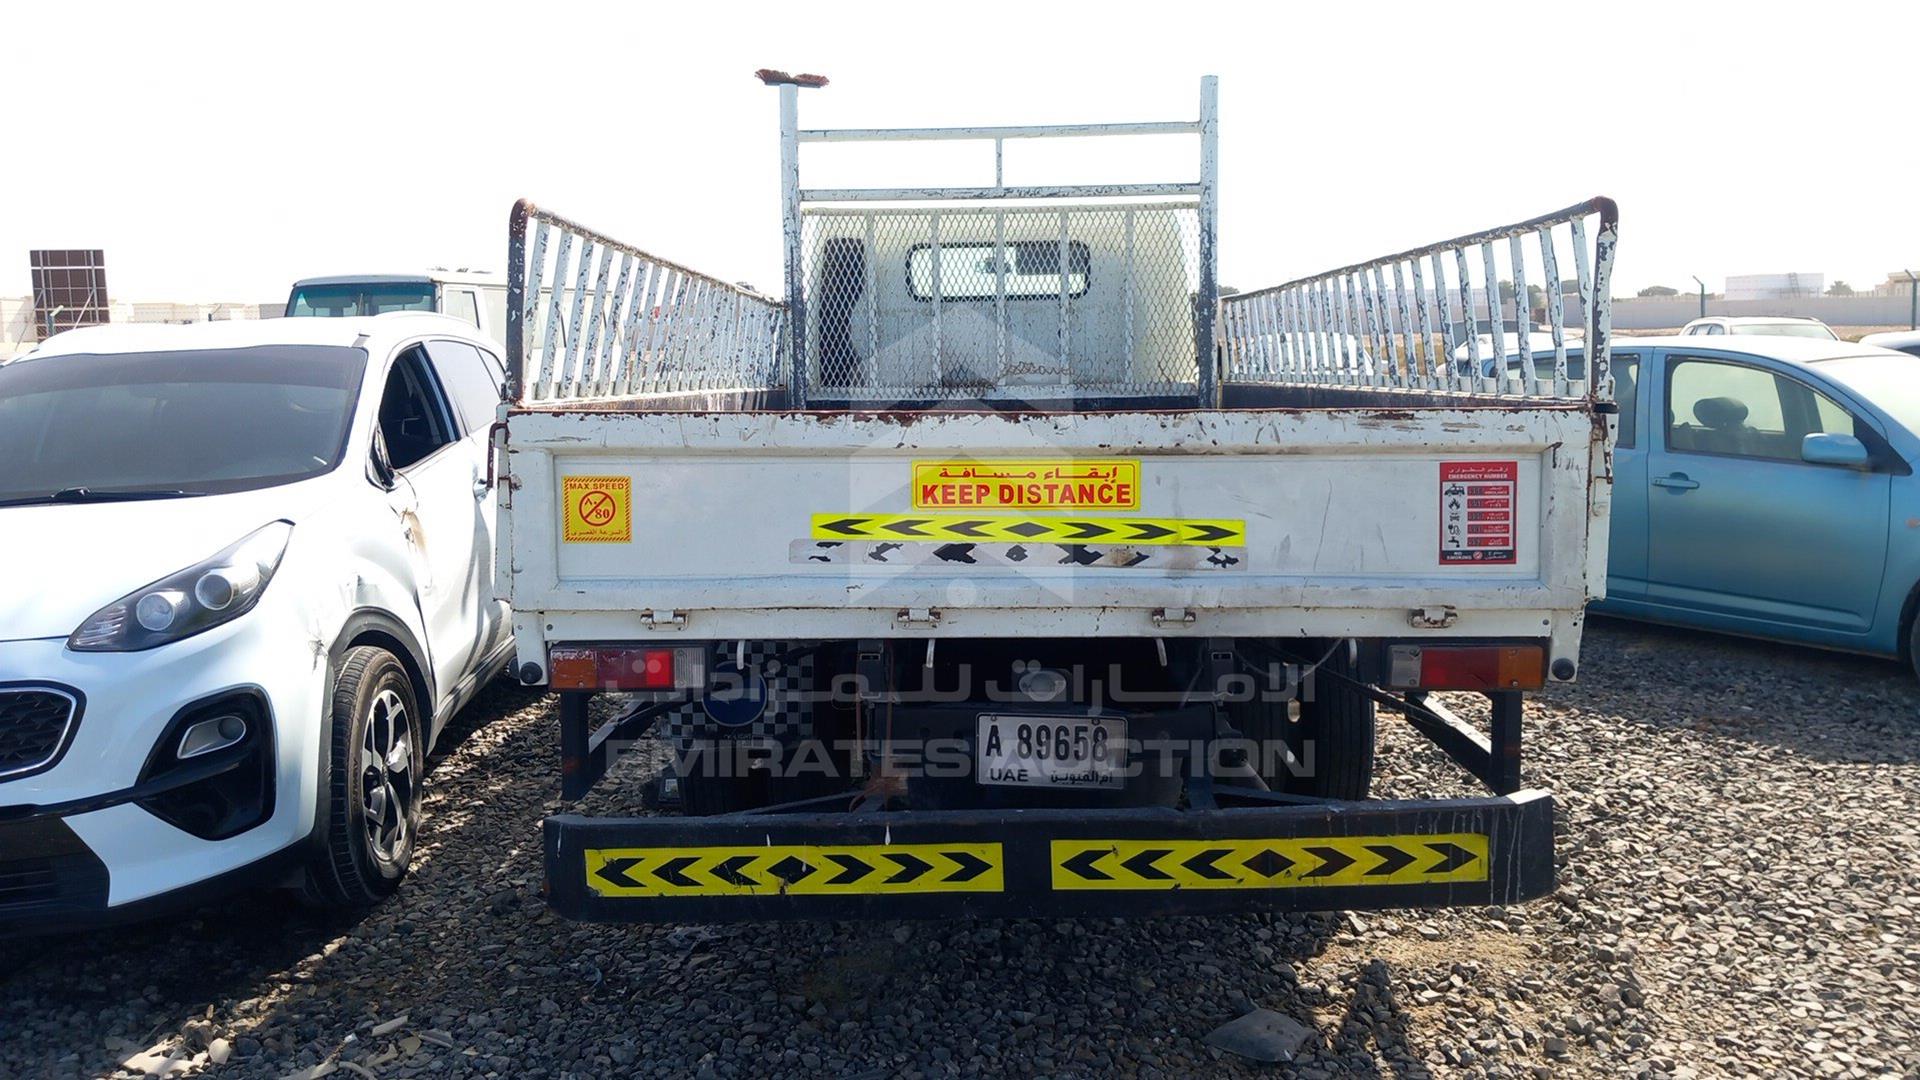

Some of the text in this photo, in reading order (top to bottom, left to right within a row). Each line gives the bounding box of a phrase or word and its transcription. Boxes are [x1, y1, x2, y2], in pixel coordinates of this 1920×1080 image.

[939, 466, 1118, 483] إبقاء مسافة
[922, 484, 1132, 505] KEEP DISTANCE
[595, 508, 610, 520] 80
[986, 724, 1108, 762] A 89658
[990, 768, 1029, 783] UAE
